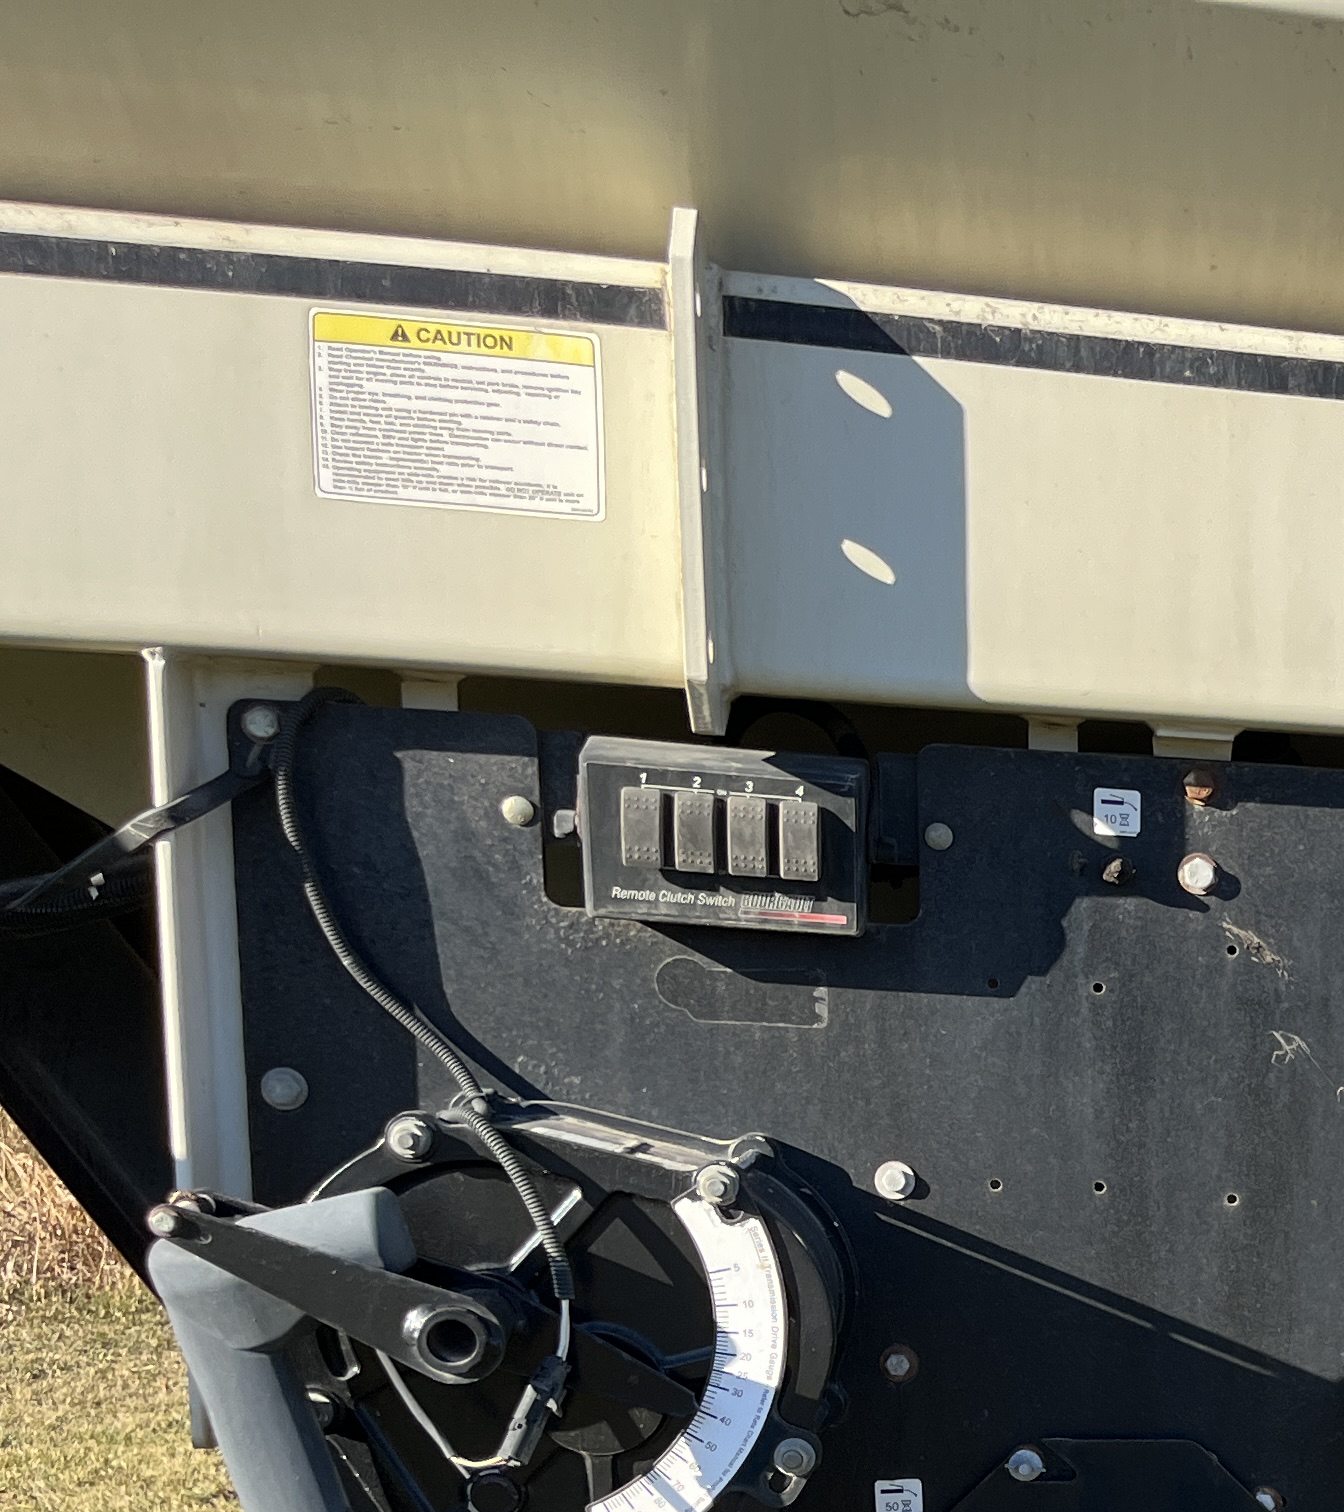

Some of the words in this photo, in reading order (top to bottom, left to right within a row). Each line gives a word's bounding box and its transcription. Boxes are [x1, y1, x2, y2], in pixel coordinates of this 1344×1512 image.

[416, 328, 513, 351] CAUTION
[640, 772, 647, 783] 1
[692, 776, 702, 788] 2
[745, 780, 753, 793] 3
[795, 785, 804, 797] 4
[1104, 813, 1117, 825] 10
[612, 886, 656, 901] Remote
[659, 890, 695, 905] Clutch
[697, 893, 735, 907] Switch
[733, 1263, 741, 1273] 5
[764, 1264, 779, 1323] Transmission
[742, 1300, 755, 1309] 10
[742, 1329, 754, 1338] 15
[771, 1326, 780, 1350] Drive
[740, 1353, 752, 1362] 20
[766, 1354, 779, 1381] Gauge
[730, 1387, 743, 1398] 30
[719, 1416, 732, 1427] 40
[704, 1440, 718, 1452] 50
[672, 1481, 685, 1493] 70
[885, 1501, 899, 1512] 50
